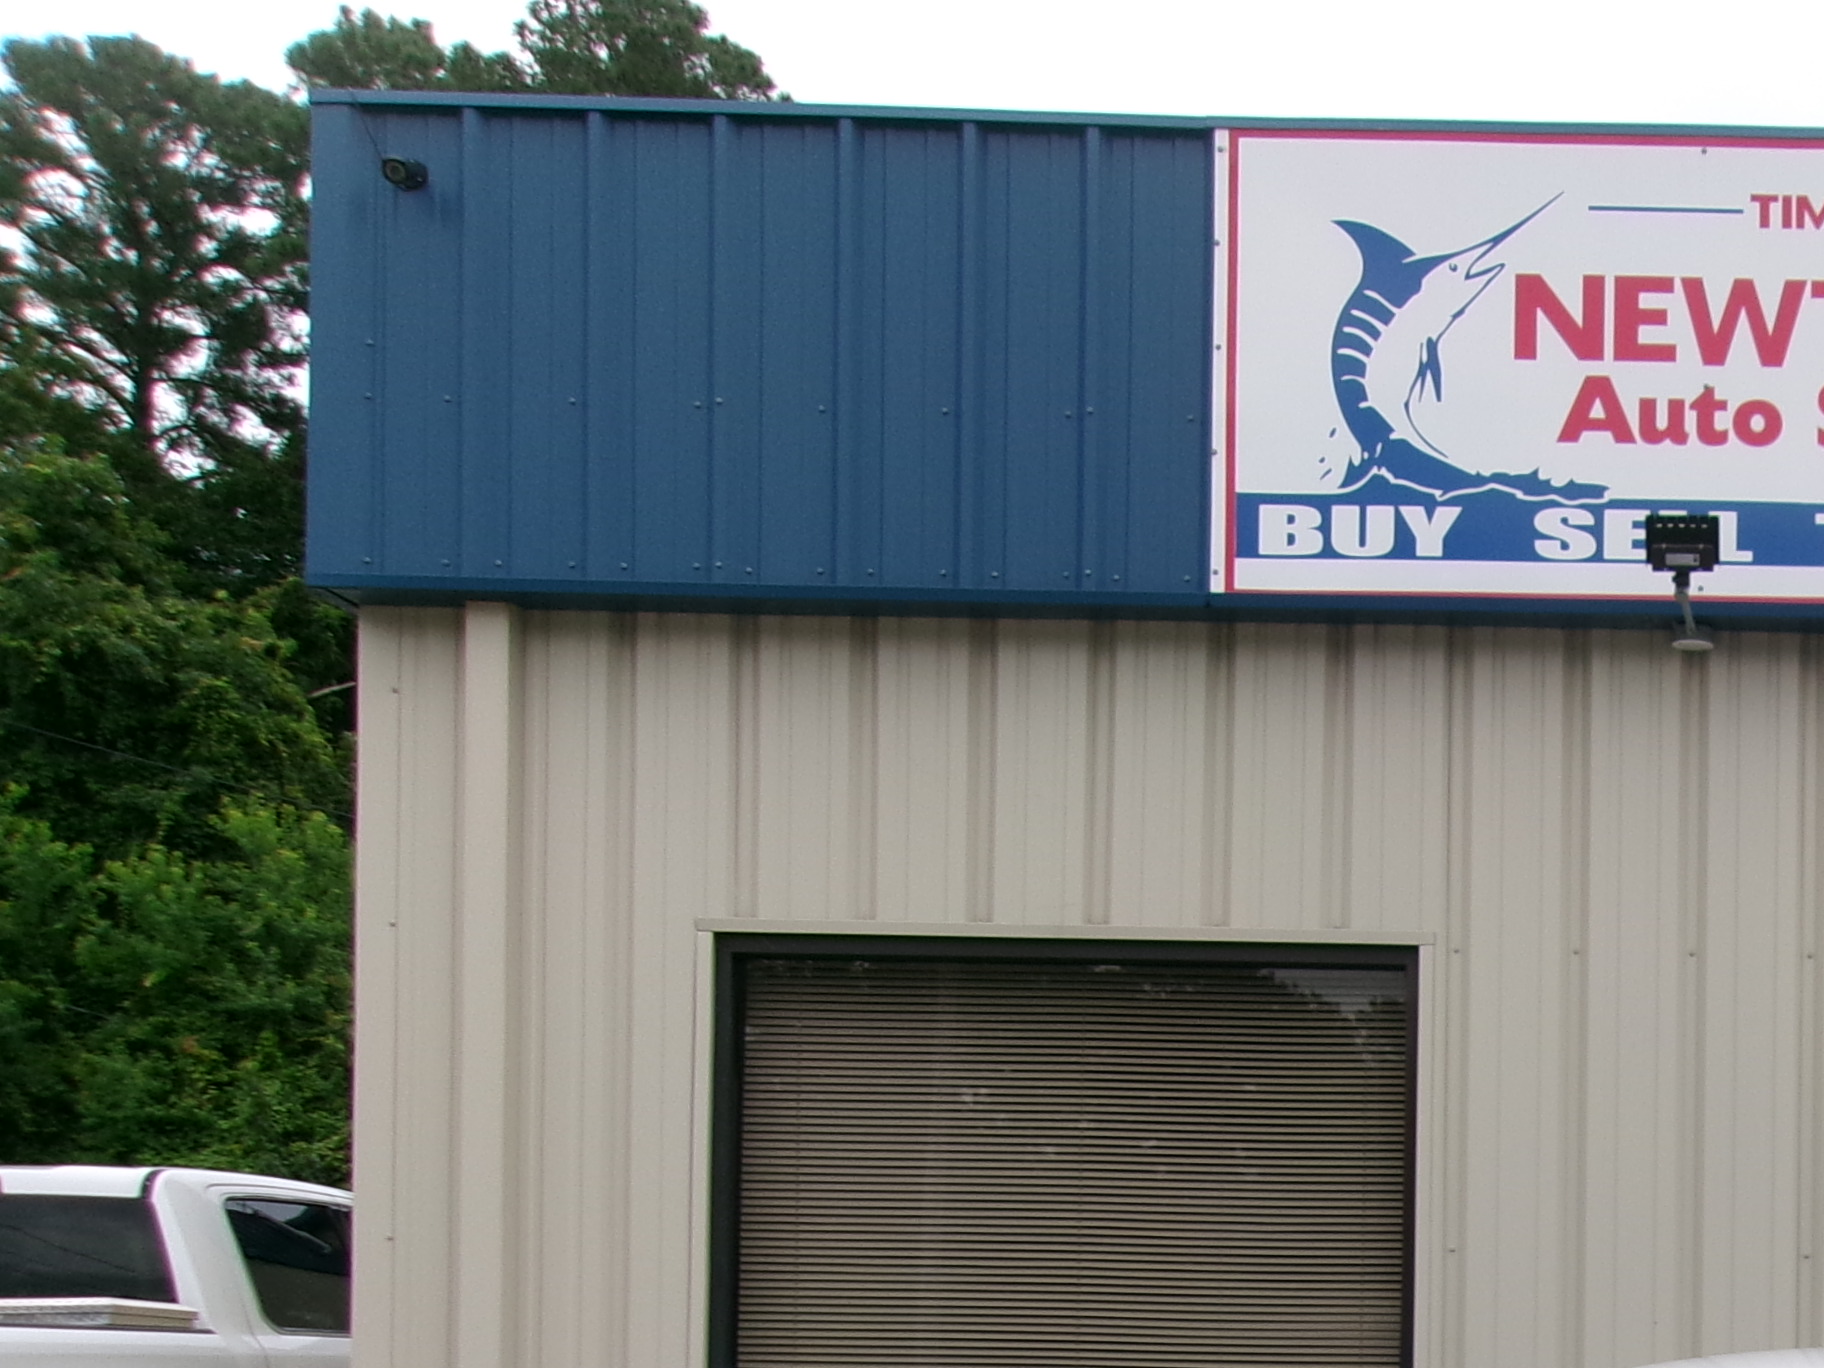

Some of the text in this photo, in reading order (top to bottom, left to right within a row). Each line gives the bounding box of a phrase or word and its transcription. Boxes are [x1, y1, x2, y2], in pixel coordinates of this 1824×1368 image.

[1556, 374, 1784, 446] Auto
[1257, 503, 1463, 559] BUY
[1533, 507, 1754, 562] SEL
